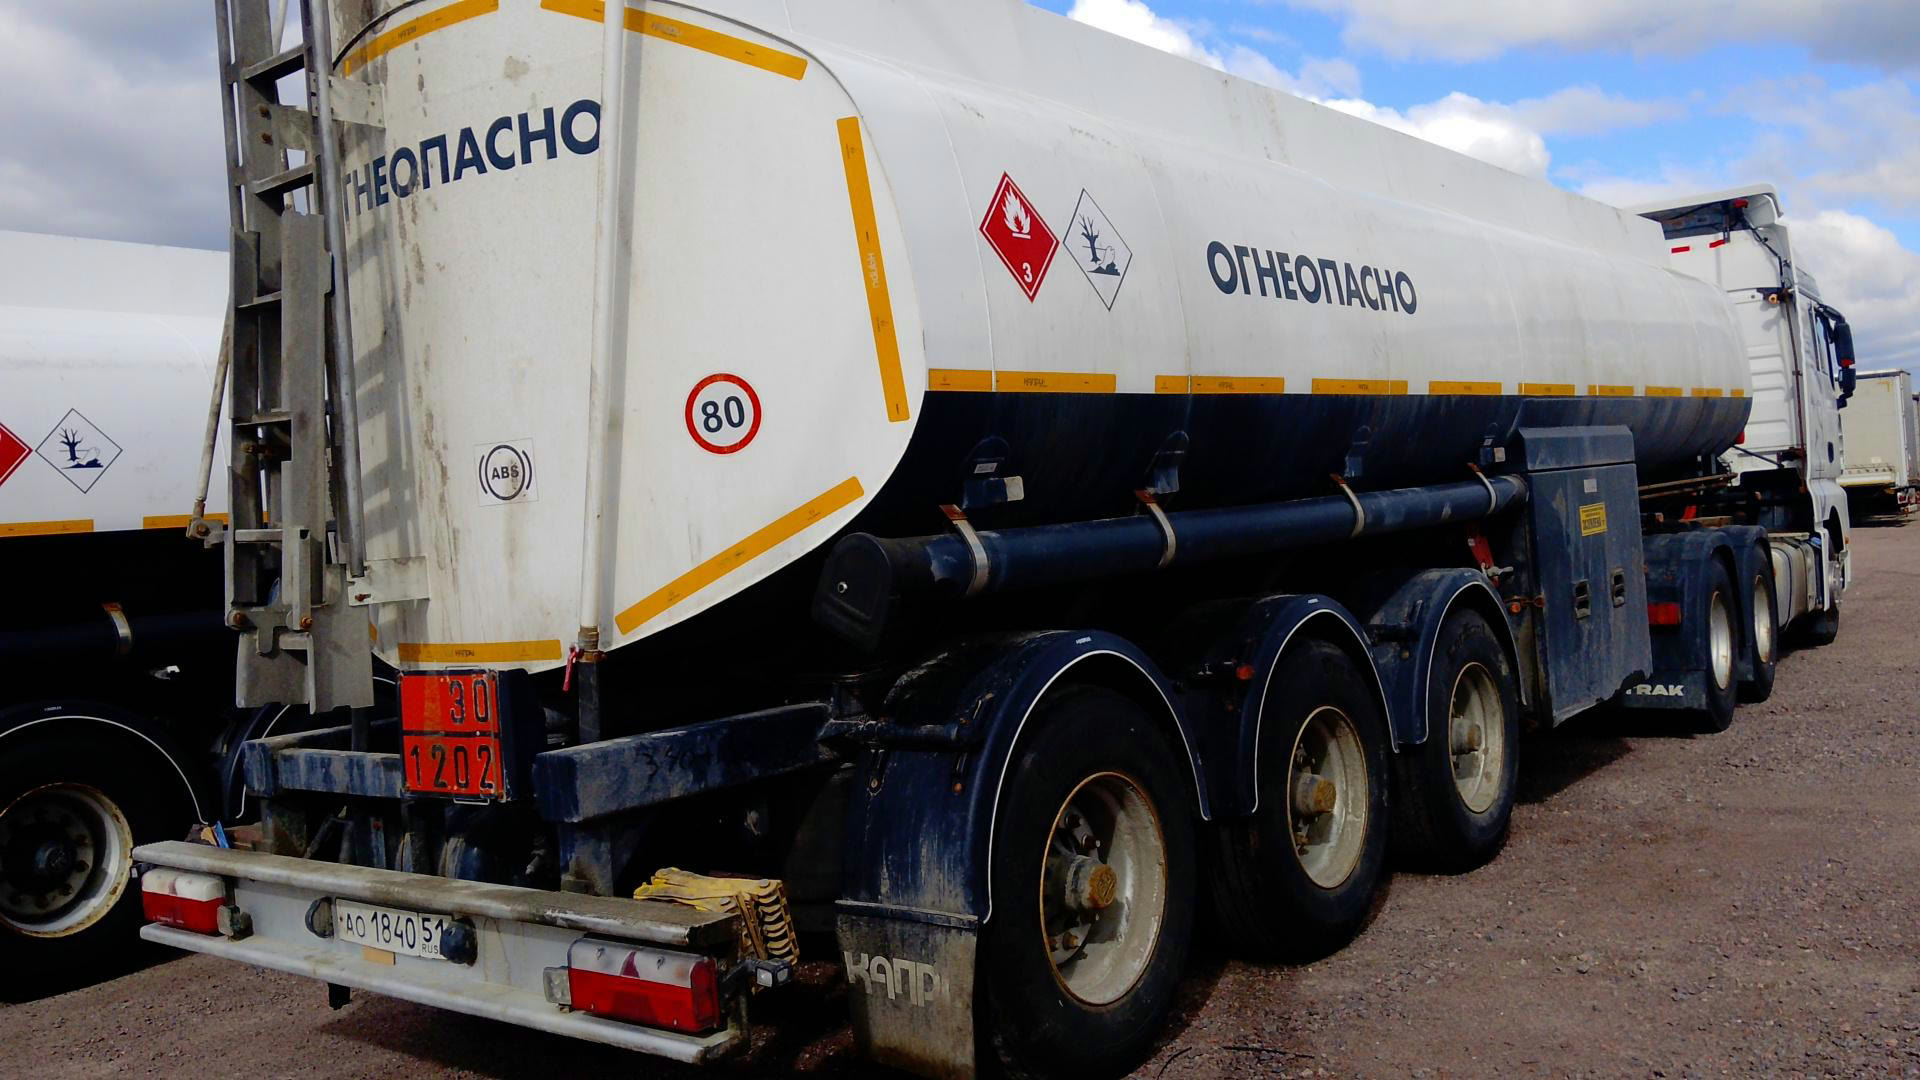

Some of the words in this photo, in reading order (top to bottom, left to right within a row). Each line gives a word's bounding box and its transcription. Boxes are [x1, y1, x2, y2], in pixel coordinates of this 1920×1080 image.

[342, 99, 601, 224] ГНЕОПАСНО
[1022, 262, 1033, 283] 3
[1207, 240, 1417, 315] ОГНЕОПАСНО
[701, 395, 745, 433] 80
[491, 464, 519, 481] ABS
[449, 679, 490, 725] 30
[410, 743, 494, 789] 1202
[422, 943, 439, 955] RUS
